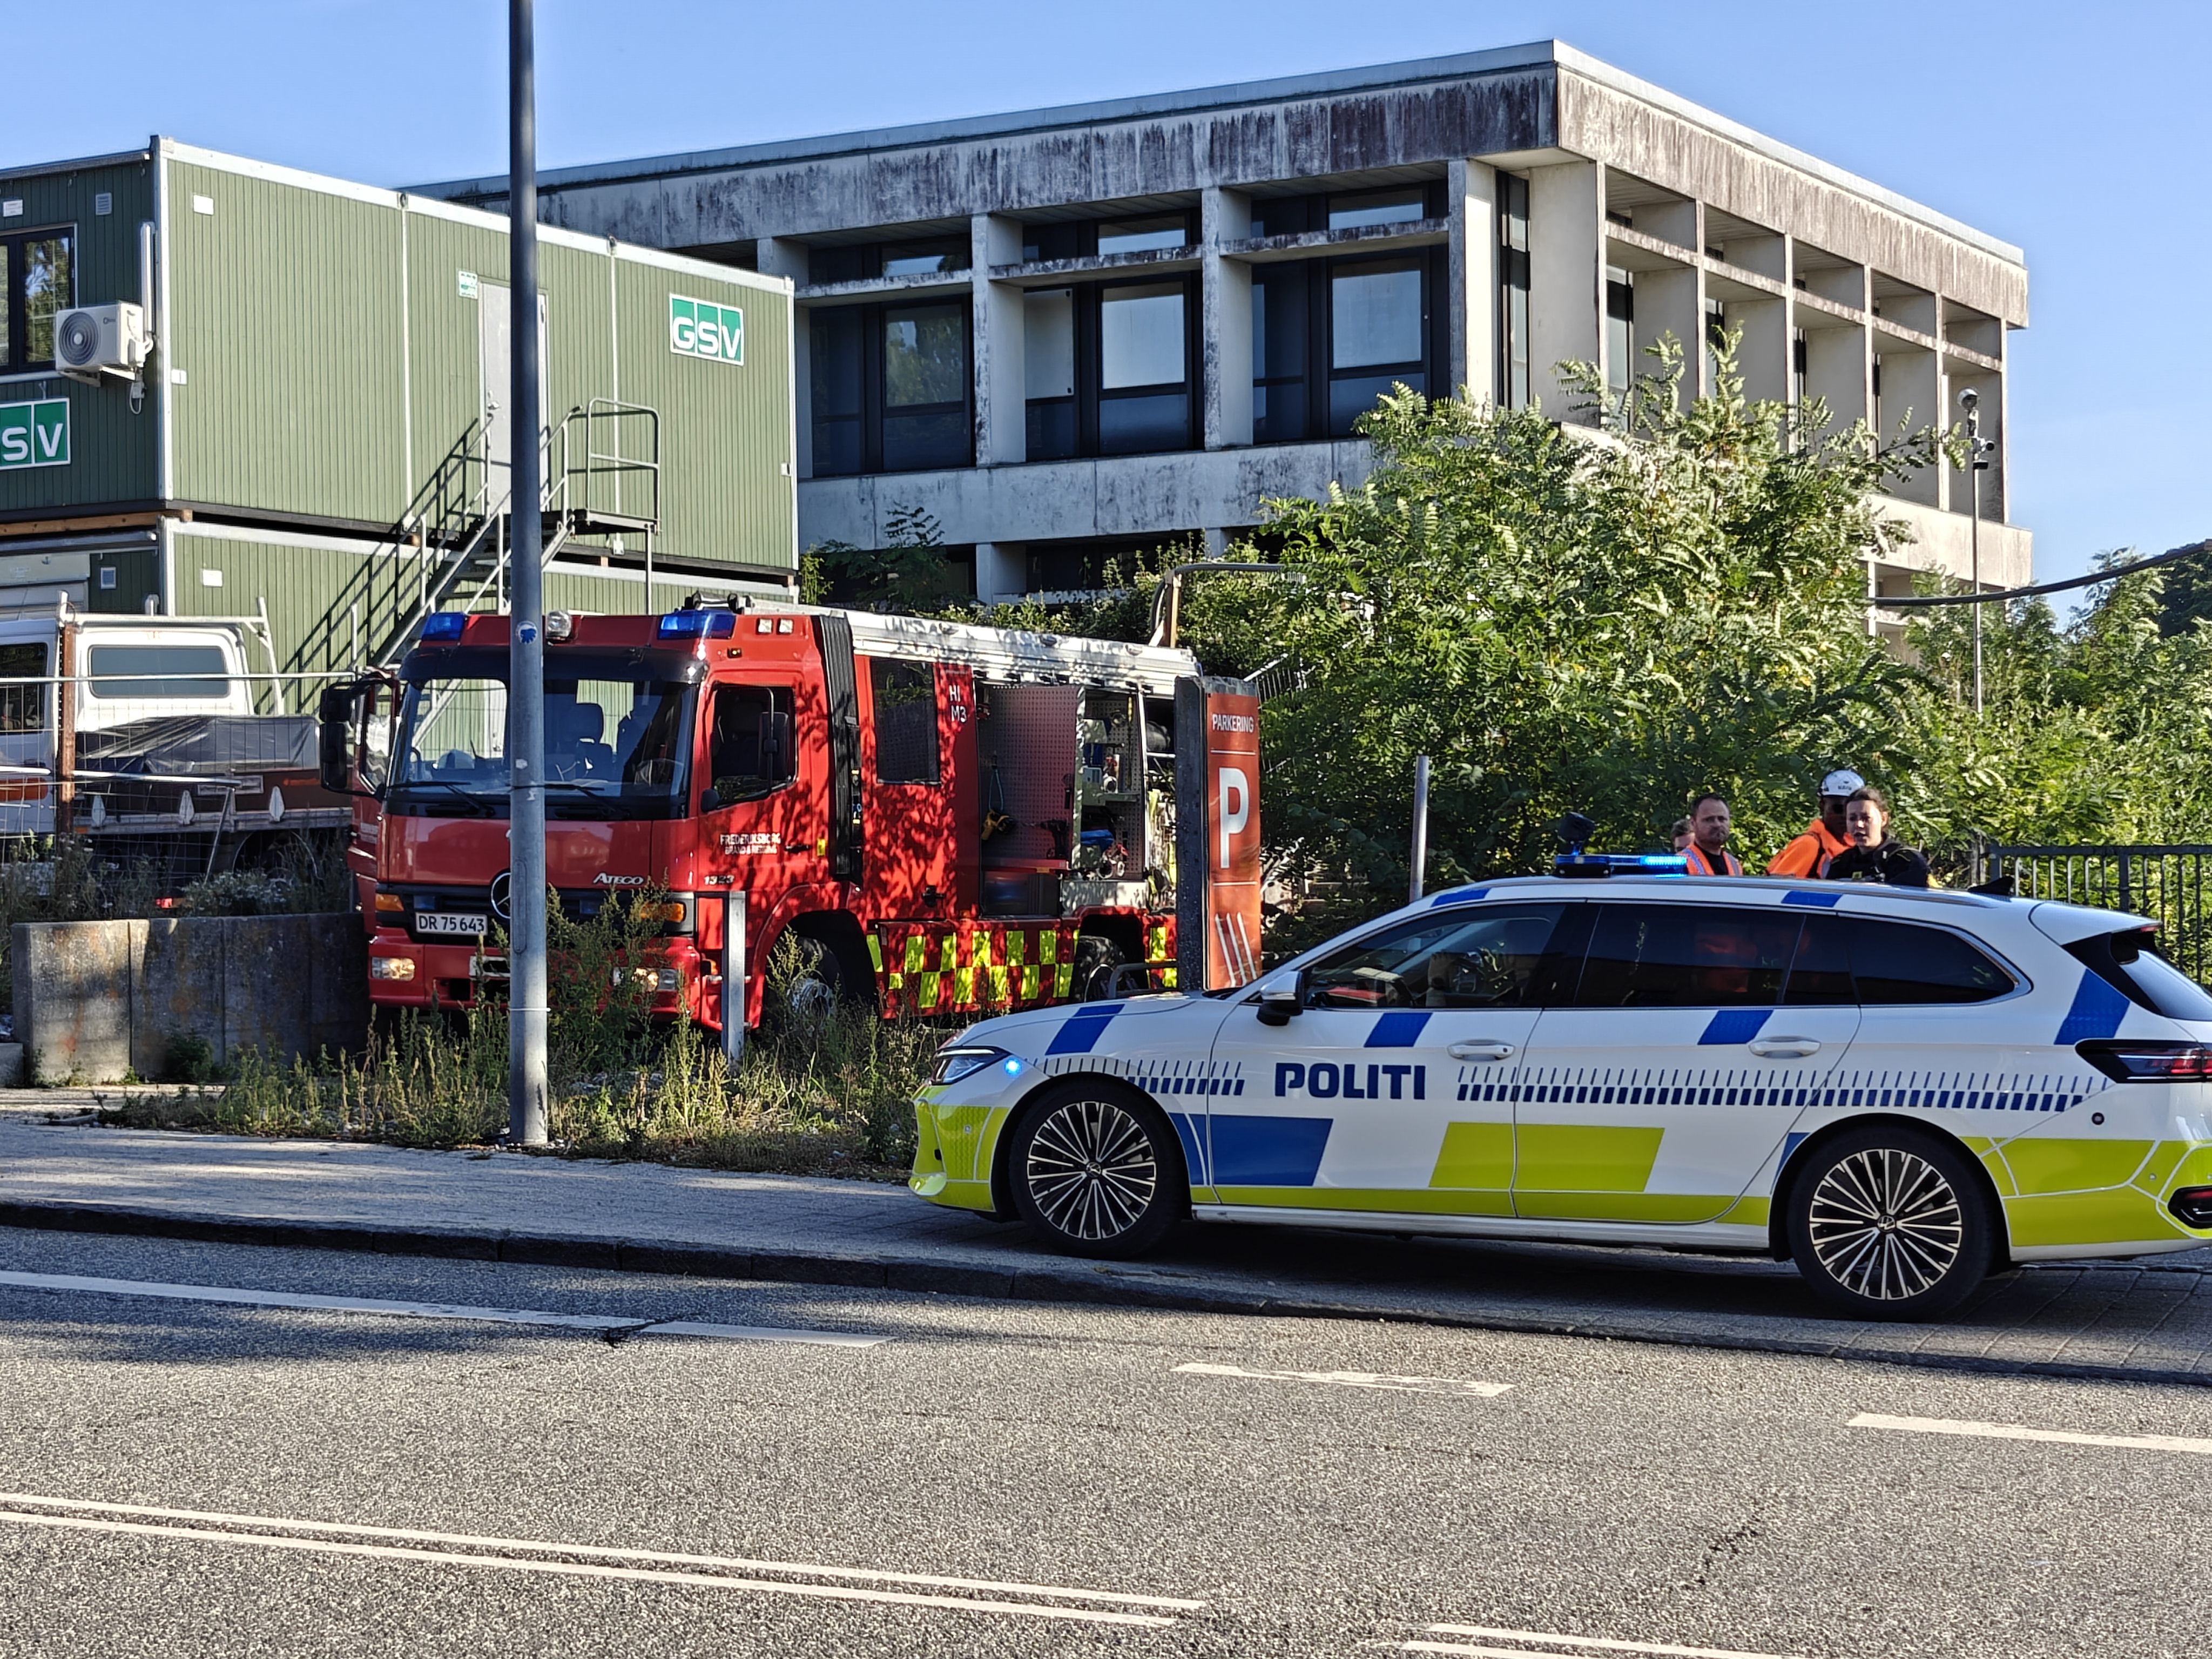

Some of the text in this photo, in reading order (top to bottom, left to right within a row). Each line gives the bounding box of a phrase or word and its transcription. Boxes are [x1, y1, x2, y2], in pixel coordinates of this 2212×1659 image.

[673, 316, 741, 358] GSV
[949, 684, 961, 702] HI
[951, 705, 967, 723] M3
[1212, 713, 1254, 733] PARKERING
[1219, 767, 1249, 869] P
[419, 915, 438, 930] DR
[1274, 1062, 1426, 1100] POLITI
